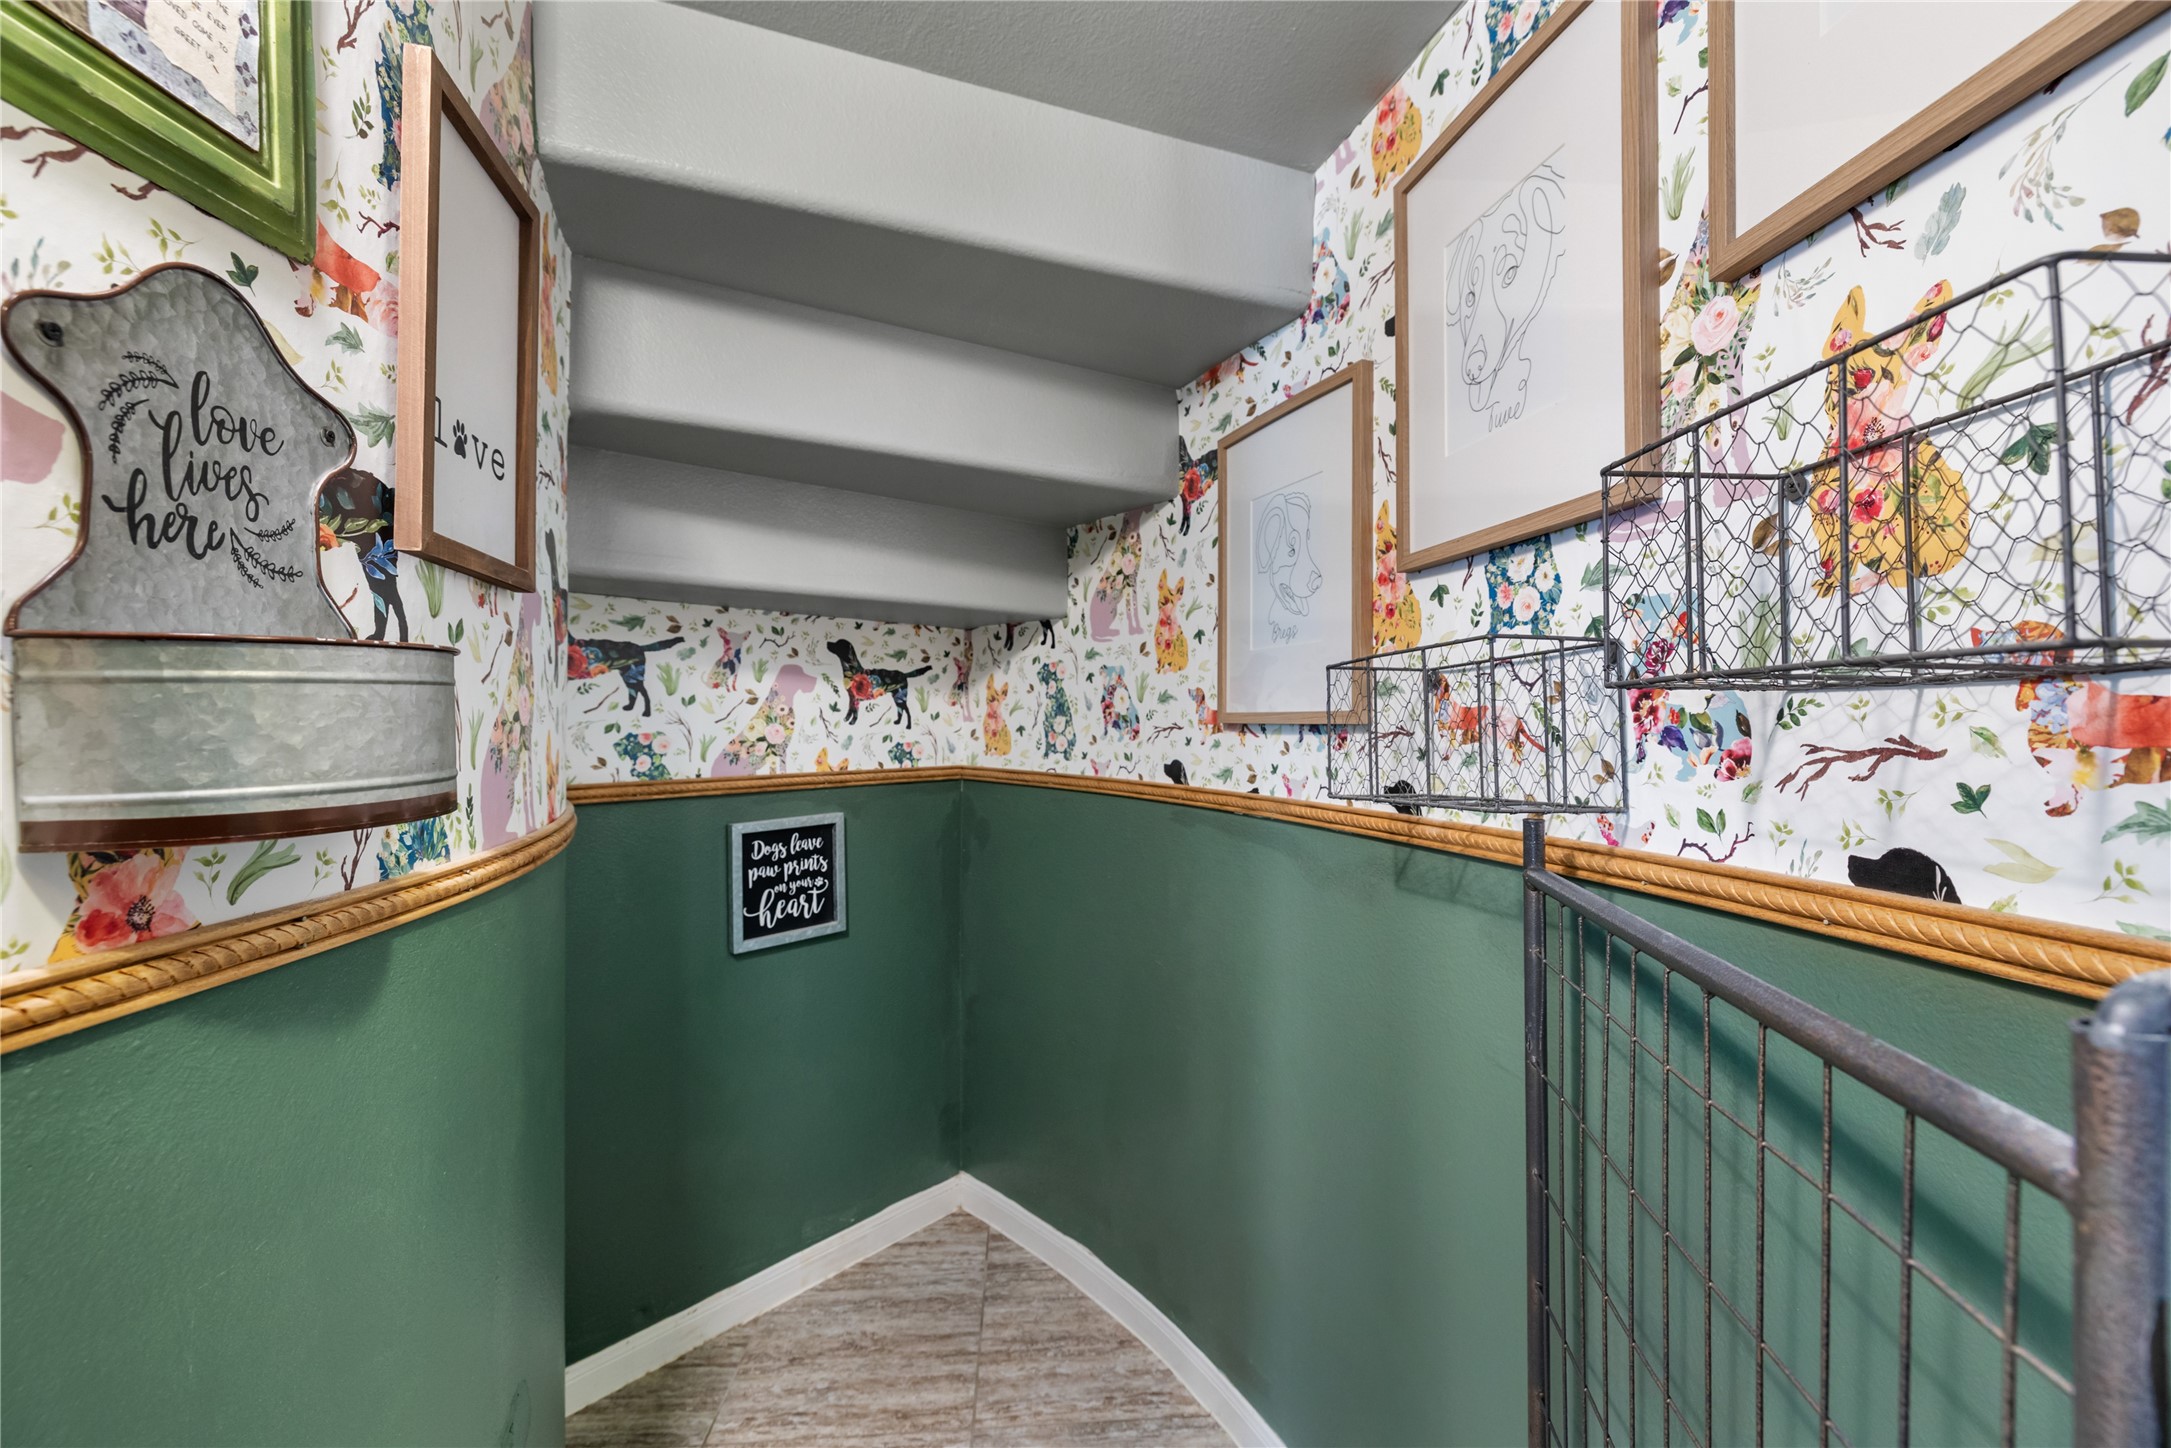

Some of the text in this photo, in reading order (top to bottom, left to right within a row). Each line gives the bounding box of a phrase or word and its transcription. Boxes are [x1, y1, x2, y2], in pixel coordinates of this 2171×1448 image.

[163, 0, 188, 20] OVED
[218, 40, 229, 54] TO
[174, 26, 215, 62] GREET US
[190, 371, 284, 456] love
[148, 410, 269, 522] lives
[101, 468, 225, 560] here
[748, 853, 828, 889] paw prints
[751, 832, 824, 861] Dogs leave
[743, 880, 829, 929] heart
[774, 876, 814, 895] on your
